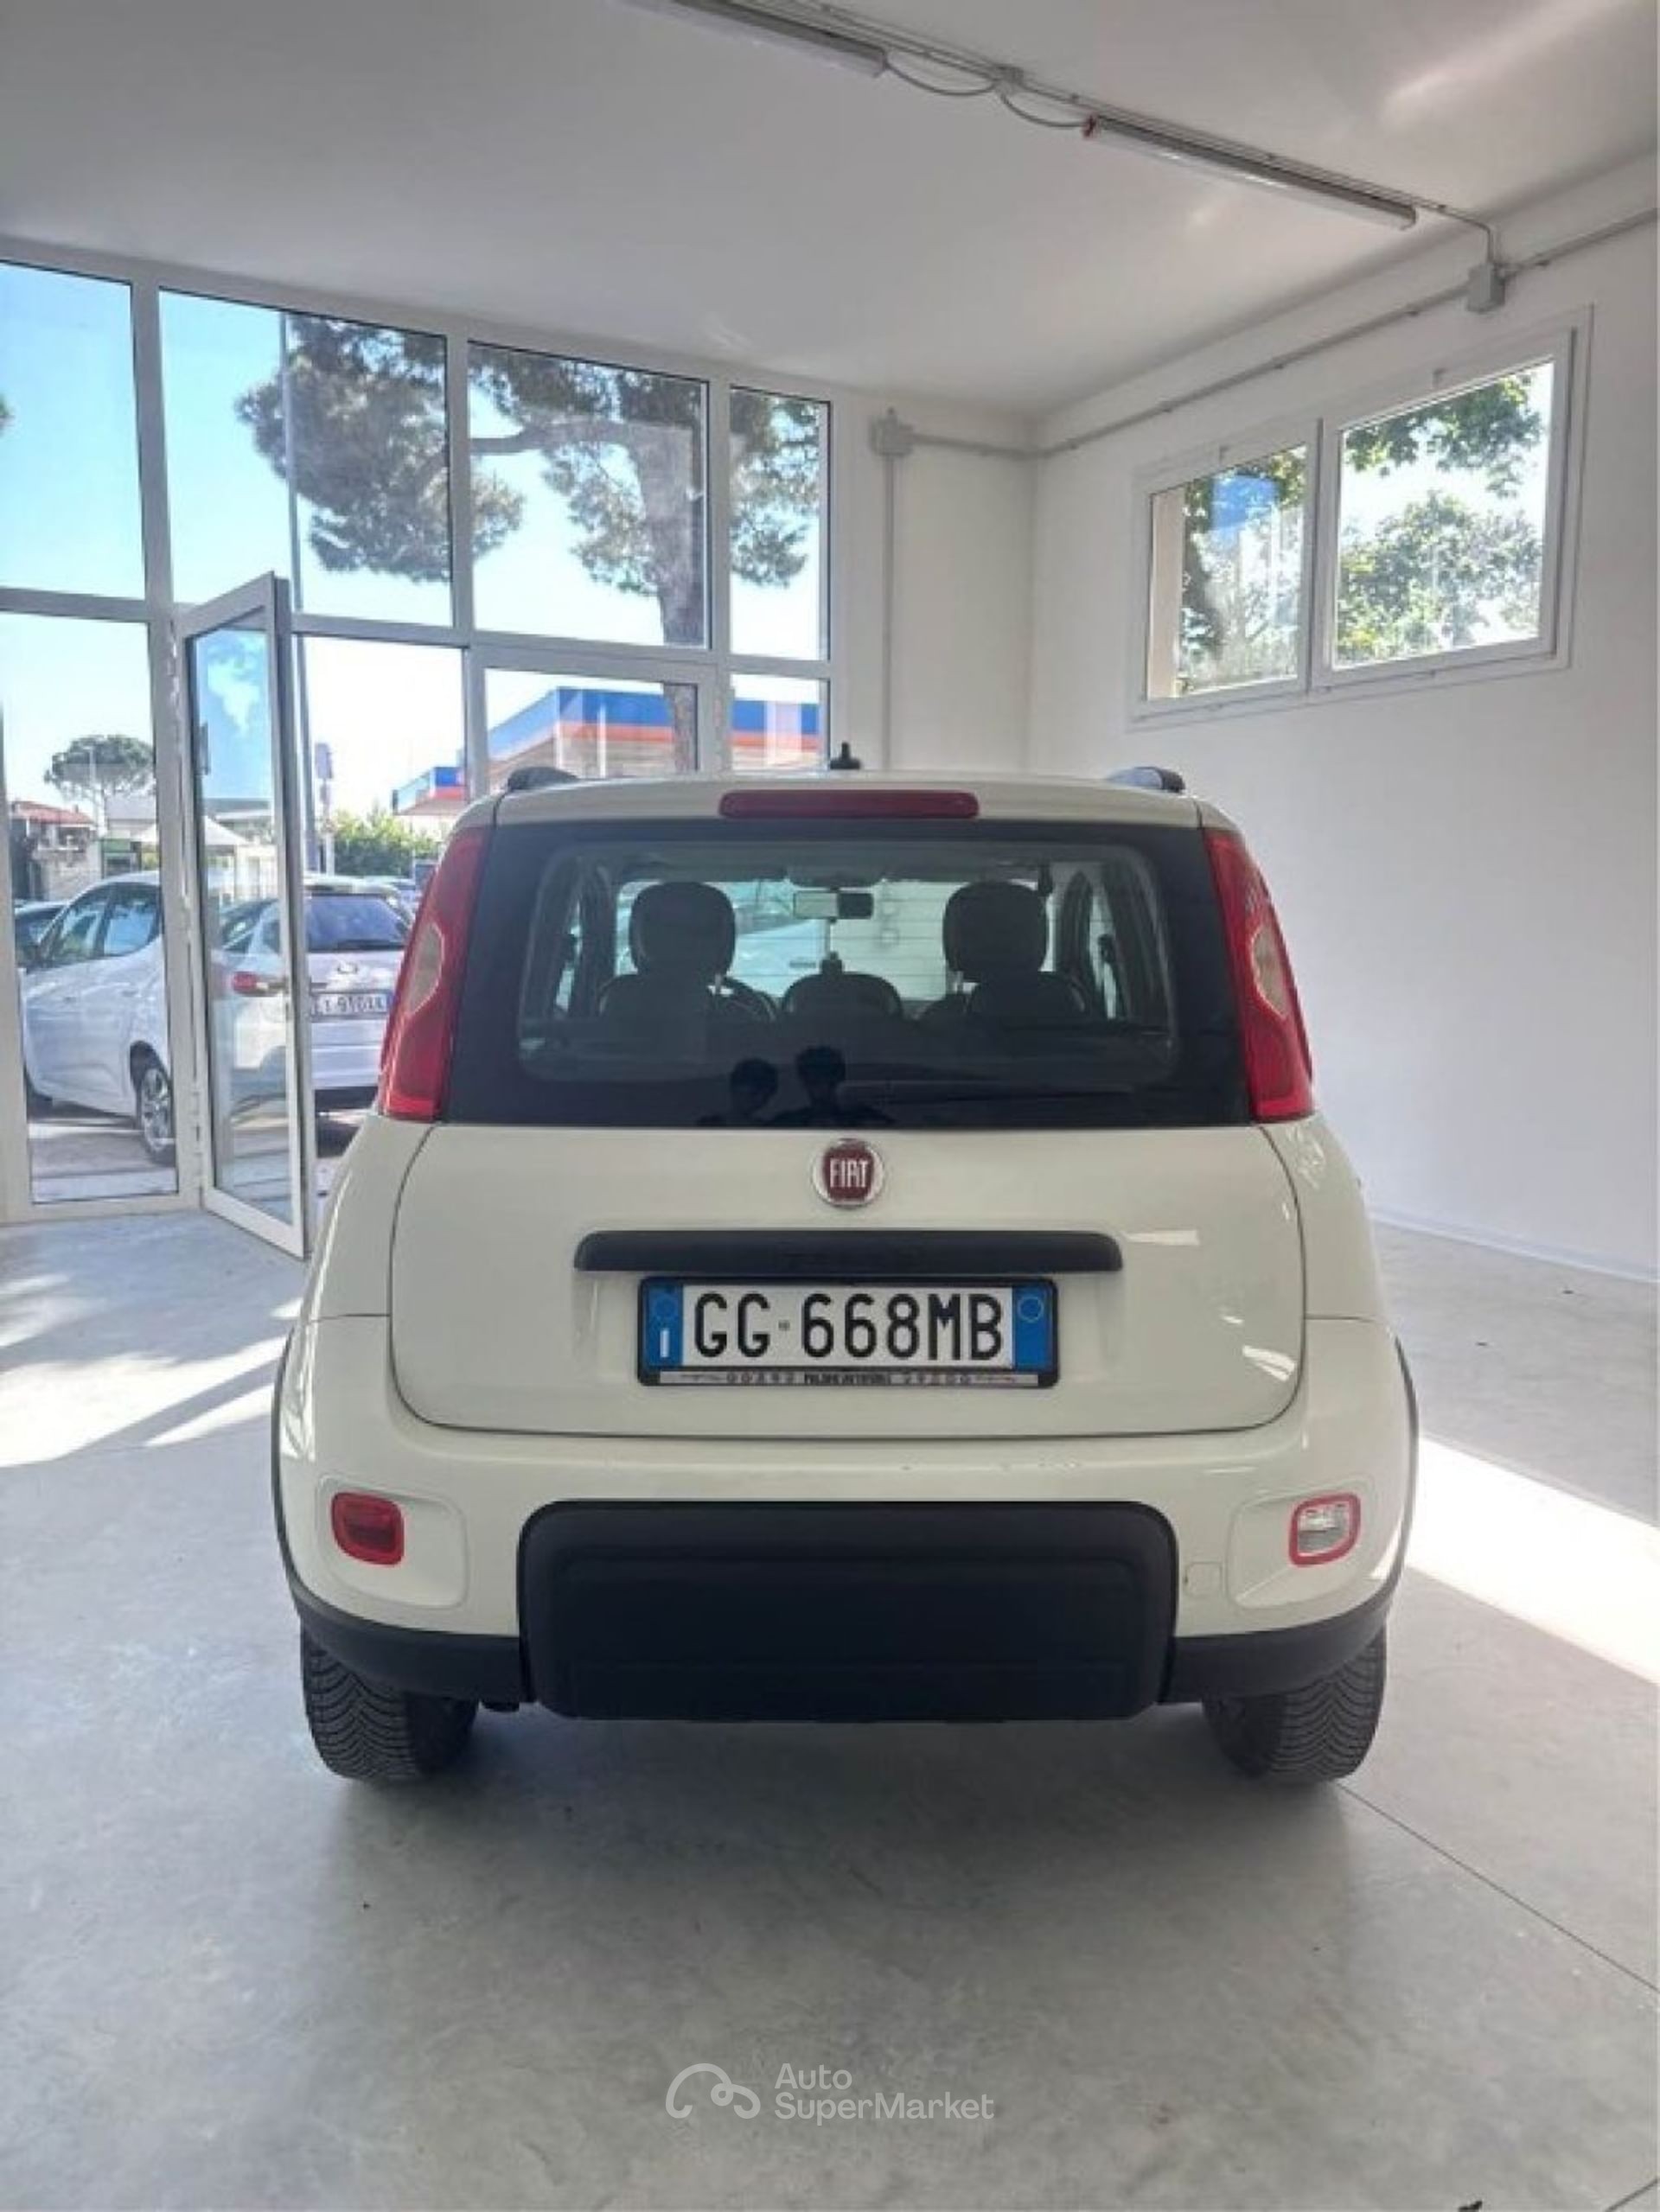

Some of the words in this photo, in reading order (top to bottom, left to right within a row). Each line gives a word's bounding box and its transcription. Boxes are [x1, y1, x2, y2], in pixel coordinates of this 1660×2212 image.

[830, 1157, 869, 1188] FIAT
[694, 1292, 771, 1358] GG
[801, 1293, 1003, 1361] 668MB
